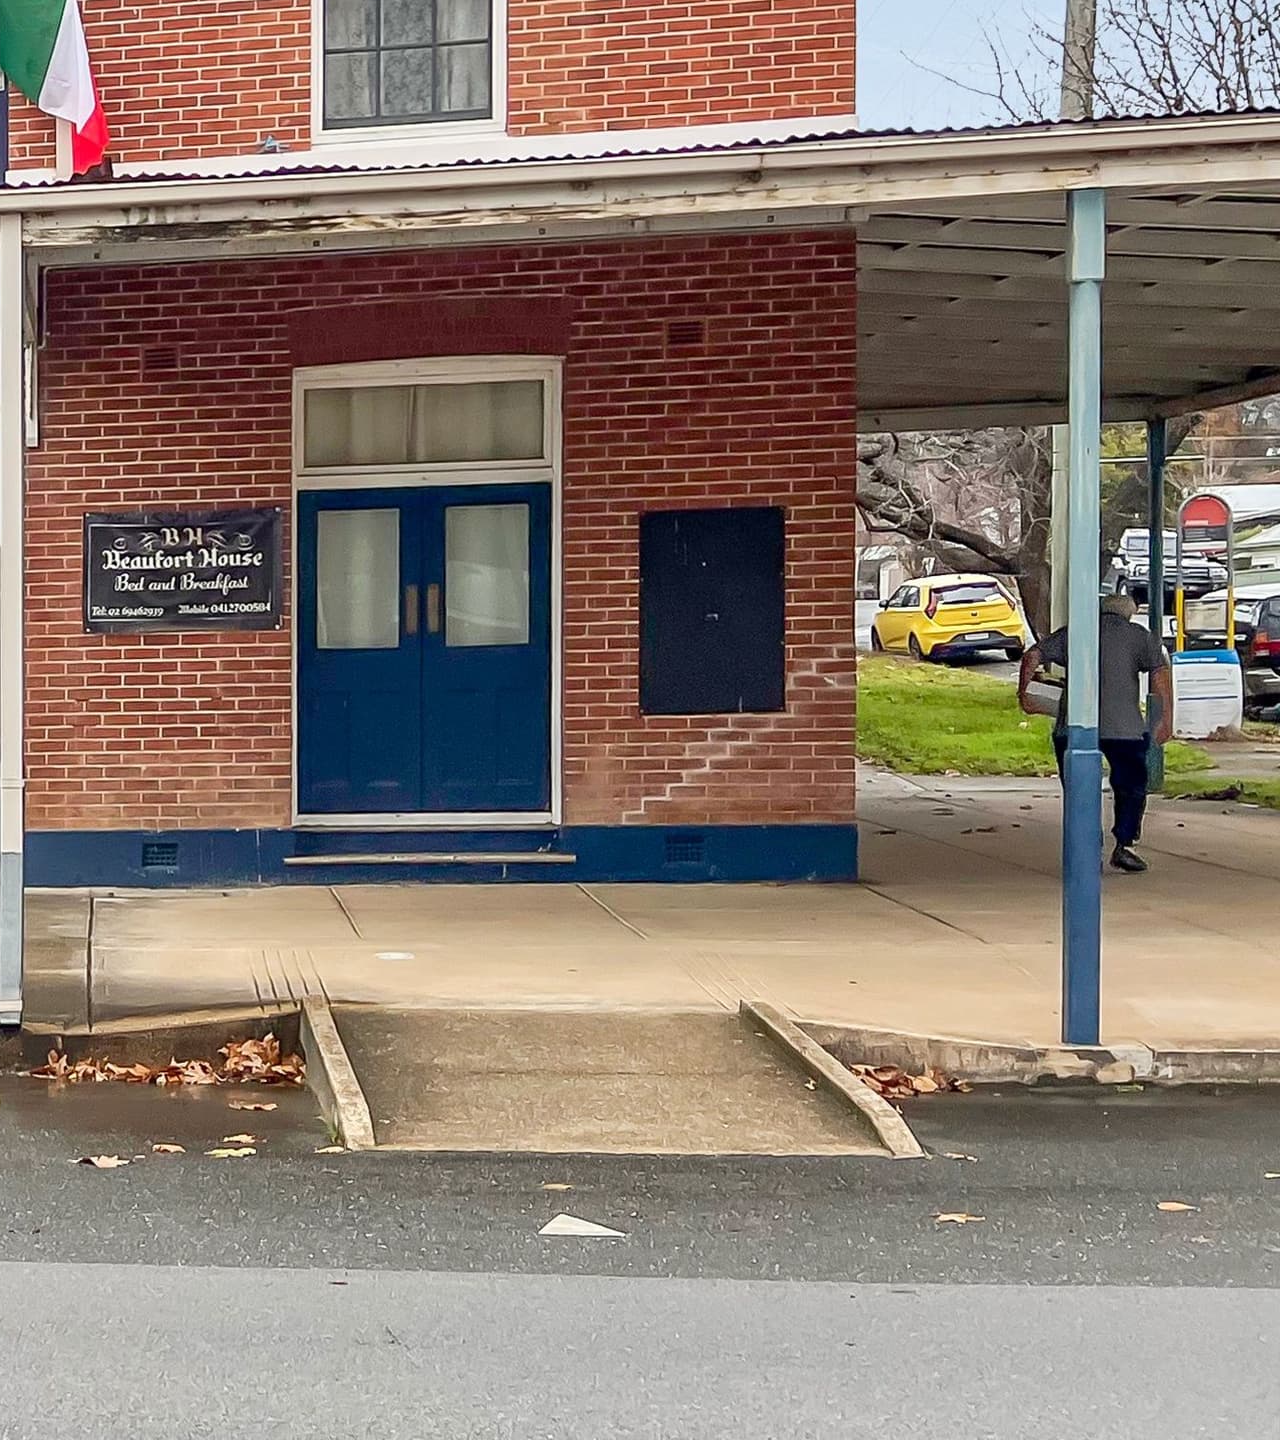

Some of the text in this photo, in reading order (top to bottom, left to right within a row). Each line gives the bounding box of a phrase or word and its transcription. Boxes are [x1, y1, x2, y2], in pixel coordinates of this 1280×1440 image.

[102, 548, 263, 569] Beaufort House
[114, 572, 248, 596] Bed and Breakfast
